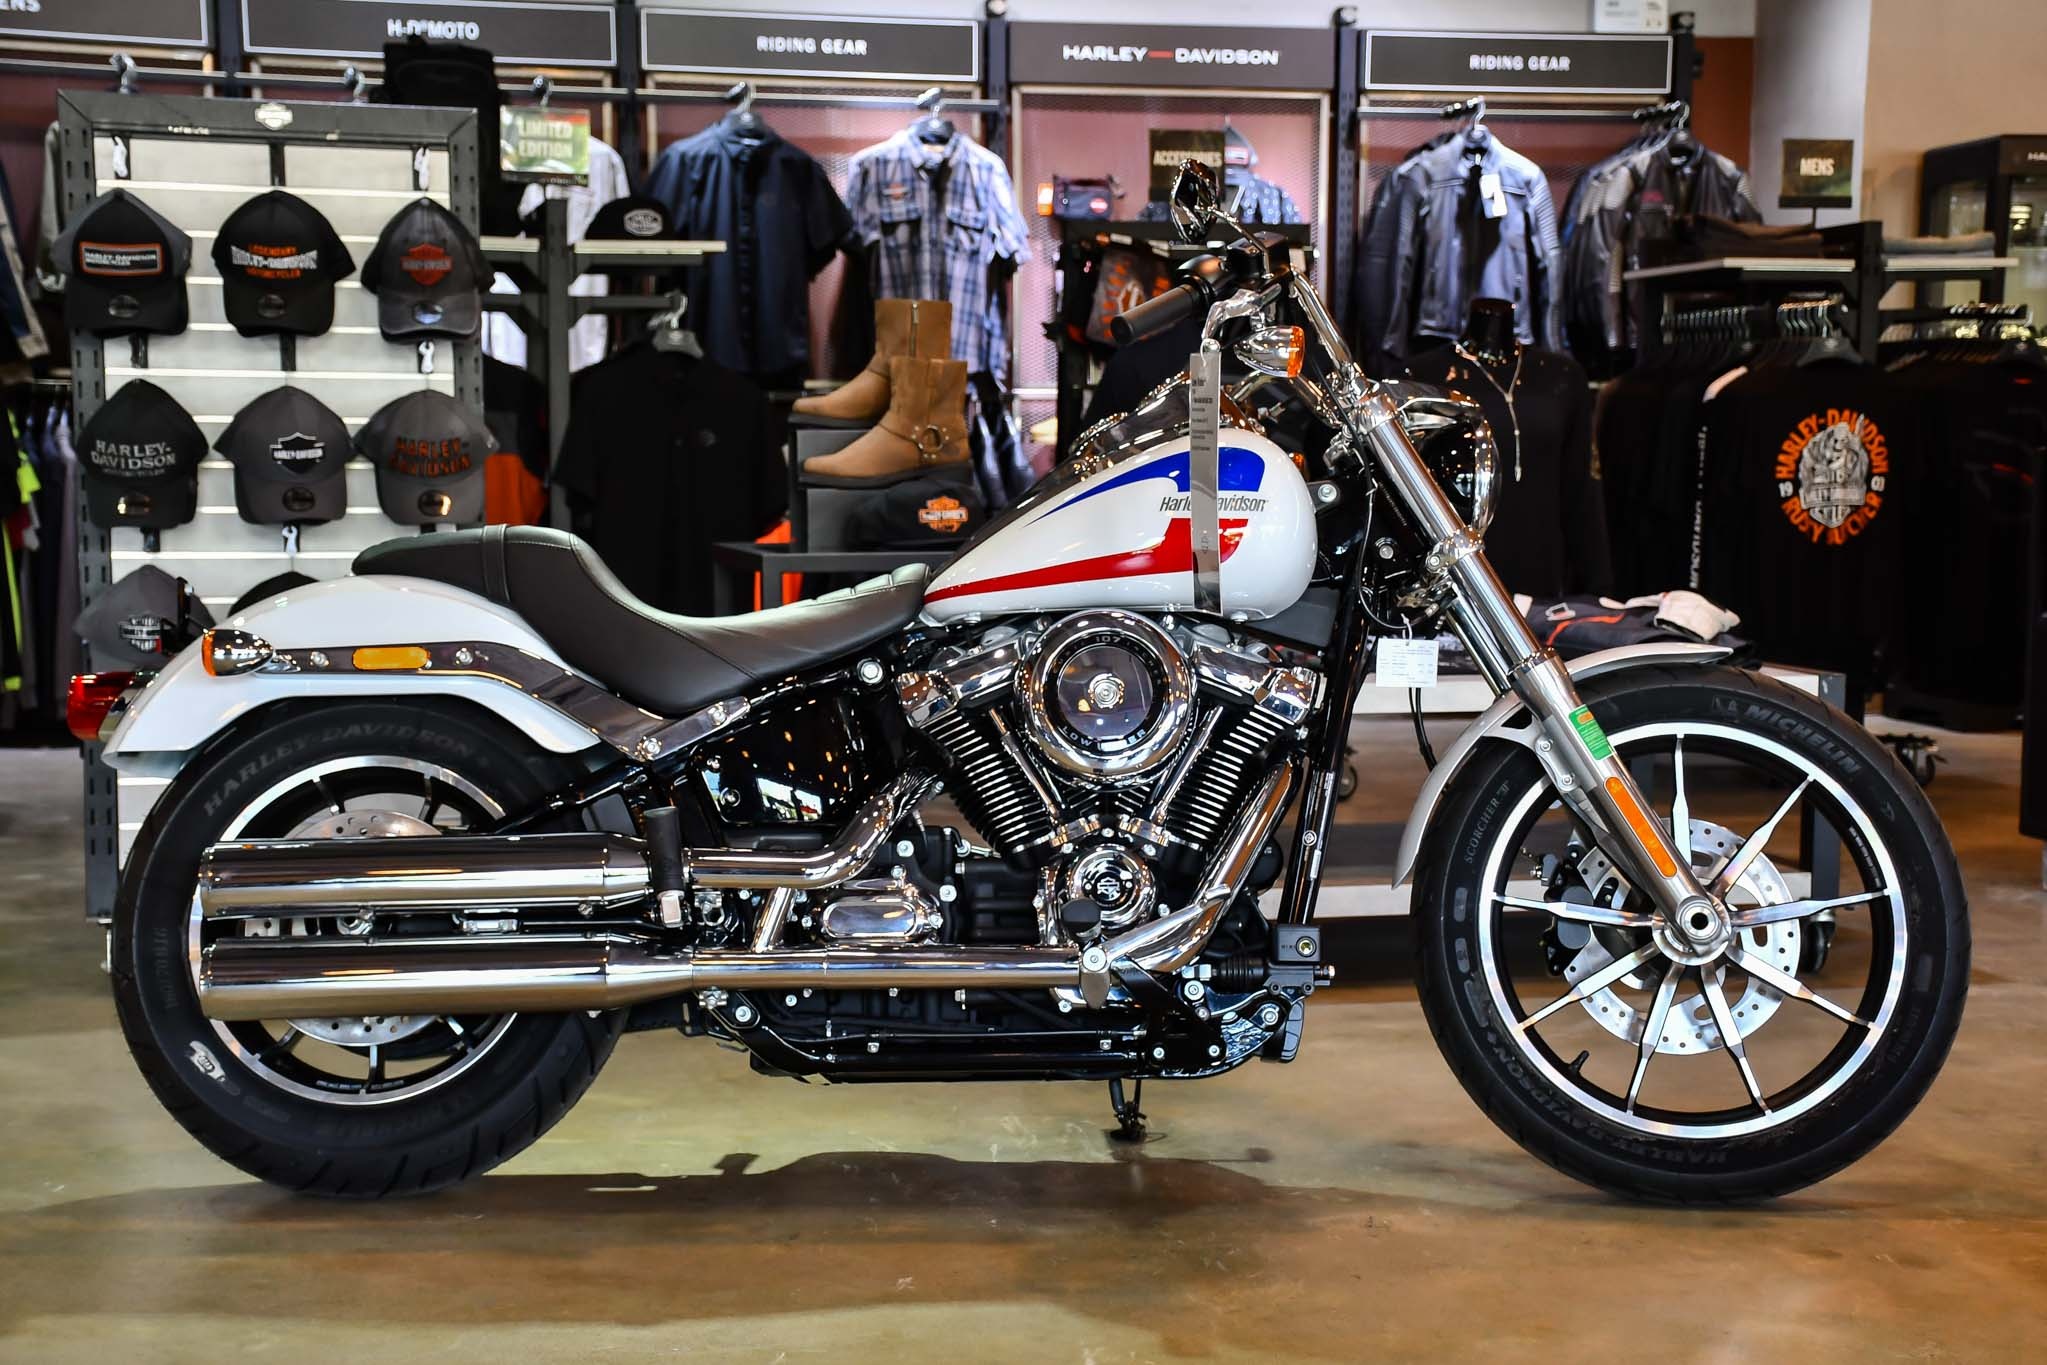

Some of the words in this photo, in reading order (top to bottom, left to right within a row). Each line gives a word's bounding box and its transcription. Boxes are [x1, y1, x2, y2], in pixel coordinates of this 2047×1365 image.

[428, 20, 480, 40] MOTO
[757, 36, 817, 53] RIDING
[821, 38, 867, 56] GEAR
[1469, 54, 1524, 71] RIDING
[1528, 55, 1571, 72] GEAR
[518, 118, 573, 139] LIMITED
[518, 139, 573, 159] EDITION
[1800, 157, 1834, 176] MENS
[91, 450, 177, 470] DAVIDSON
[1095, 635, 1122, 644] 107
[1062, 726, 1093, 748] LOW
[1743, 704, 1863, 776] MICHELIN
[1463, 797, 1501, 865] SCORCHER
